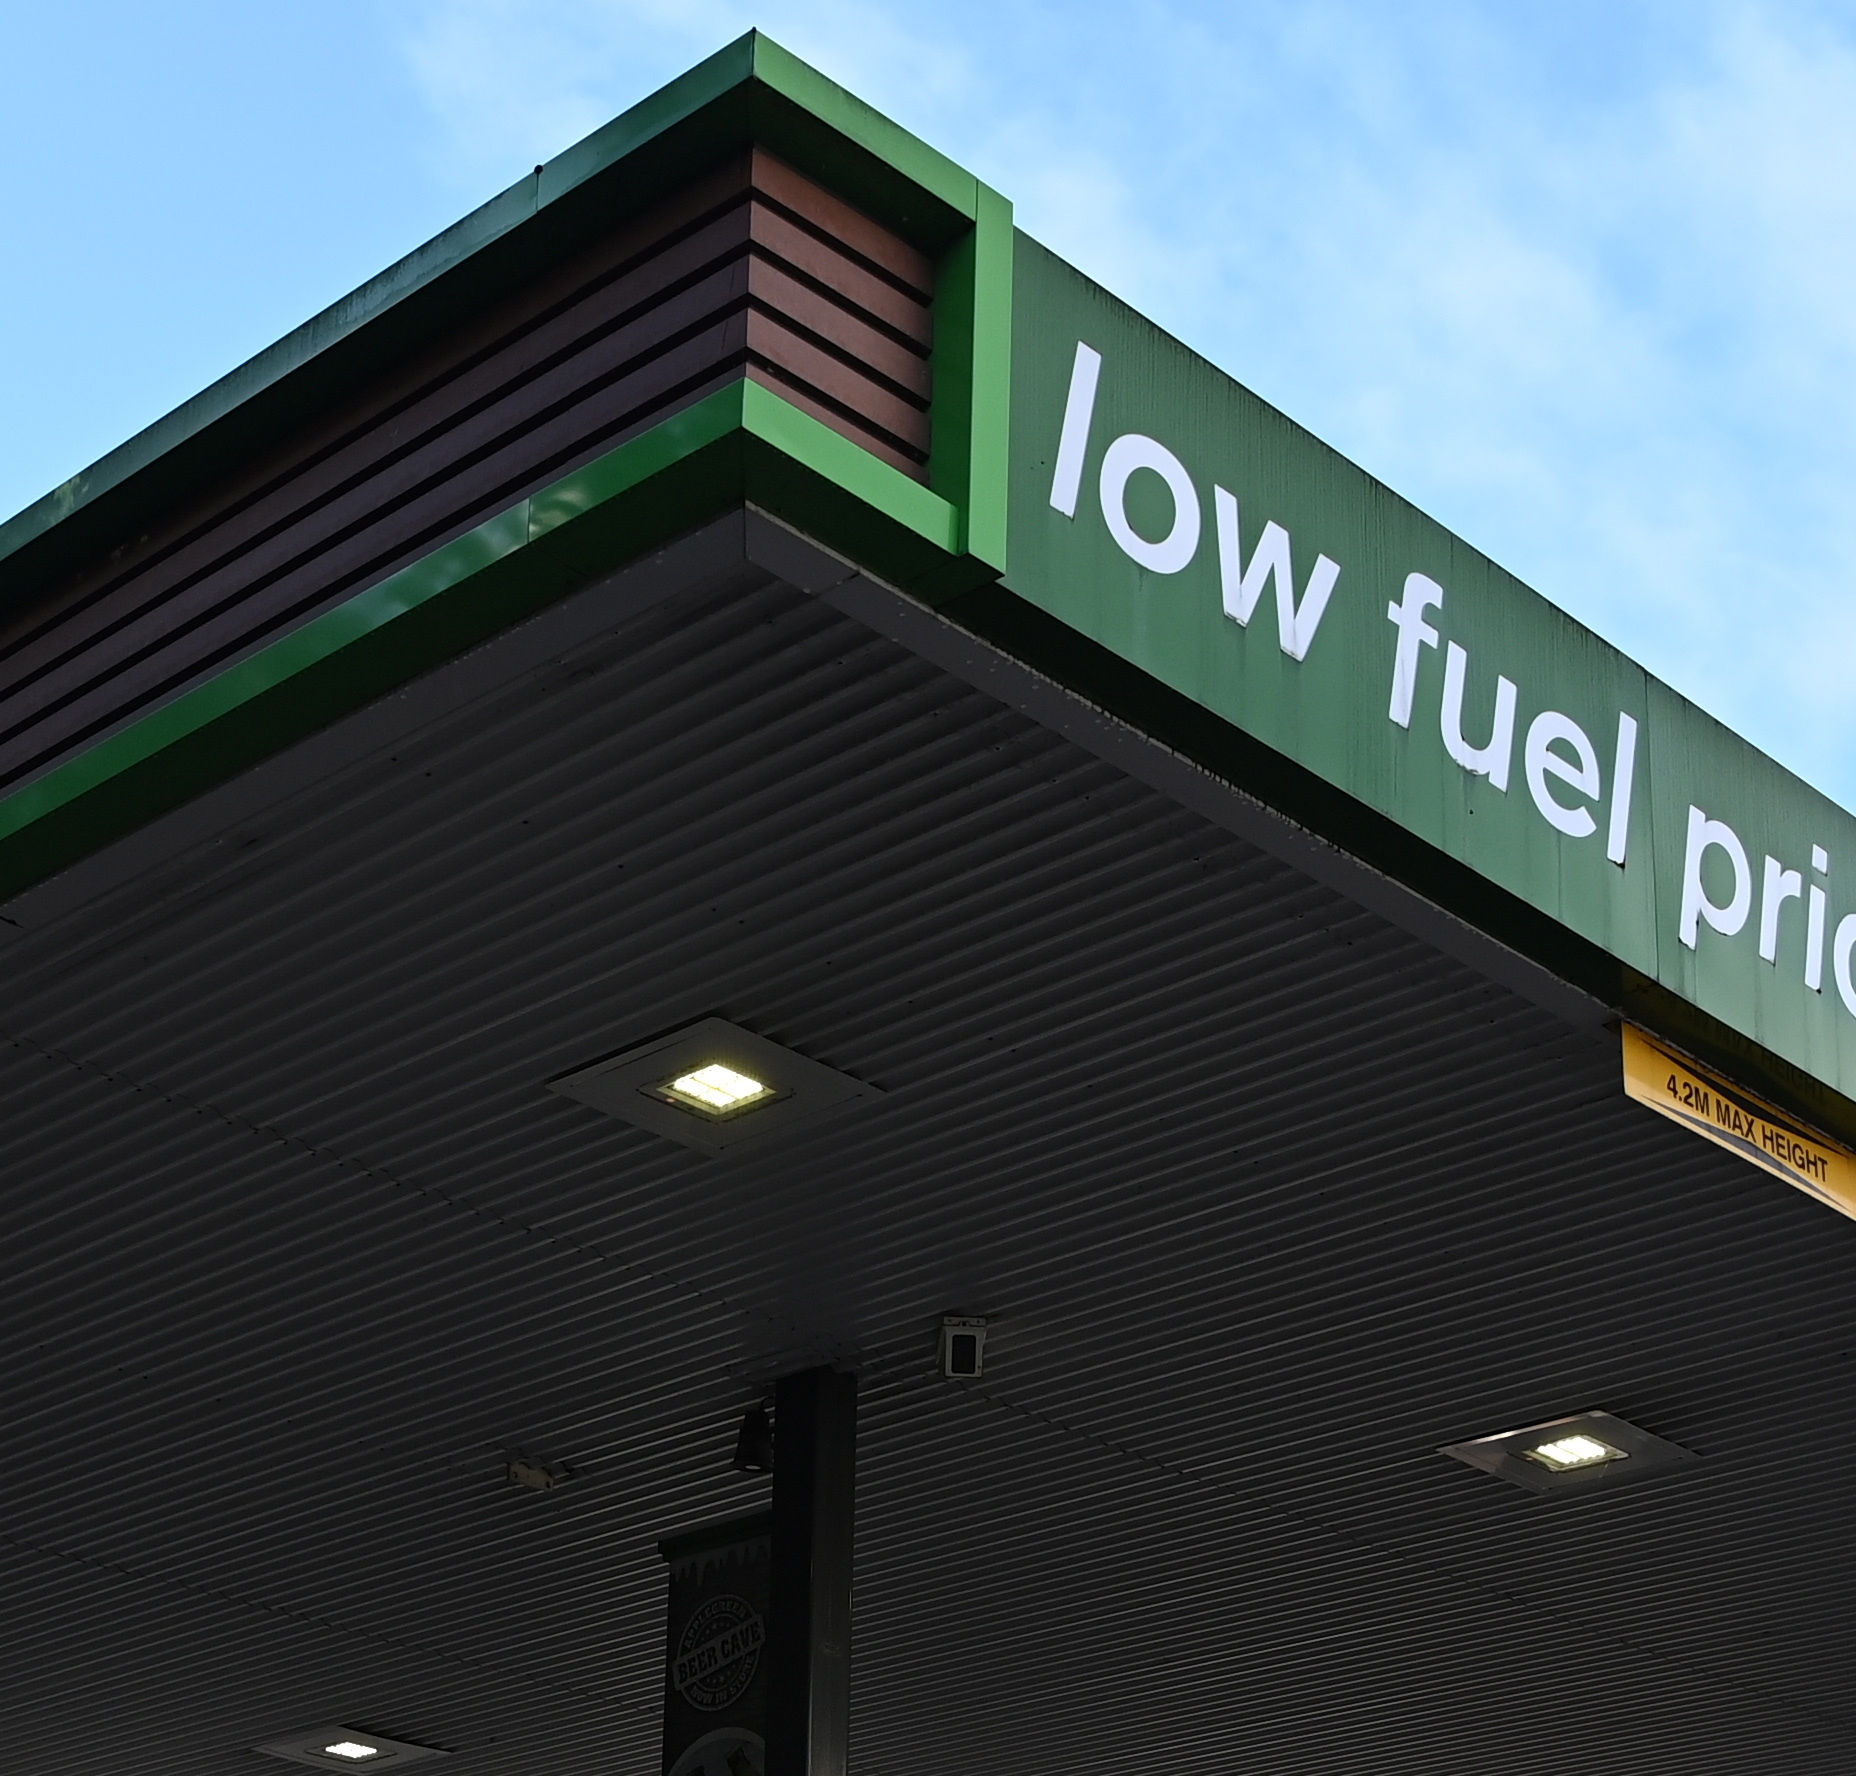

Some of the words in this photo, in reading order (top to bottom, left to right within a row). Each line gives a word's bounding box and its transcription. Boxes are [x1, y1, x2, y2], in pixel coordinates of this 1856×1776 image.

[1050, 342, 1340, 661] low
[1388, 573, 1637, 867] fuel
[1667, 1075, 1710, 1116] 4.2M
[1716, 1100, 1756, 1143] MAX
[1762, 1125, 1828, 1182] HEIGHT
[678, 1647, 718, 1684] BEER
[721, 1621, 760, 1658] CAVE
